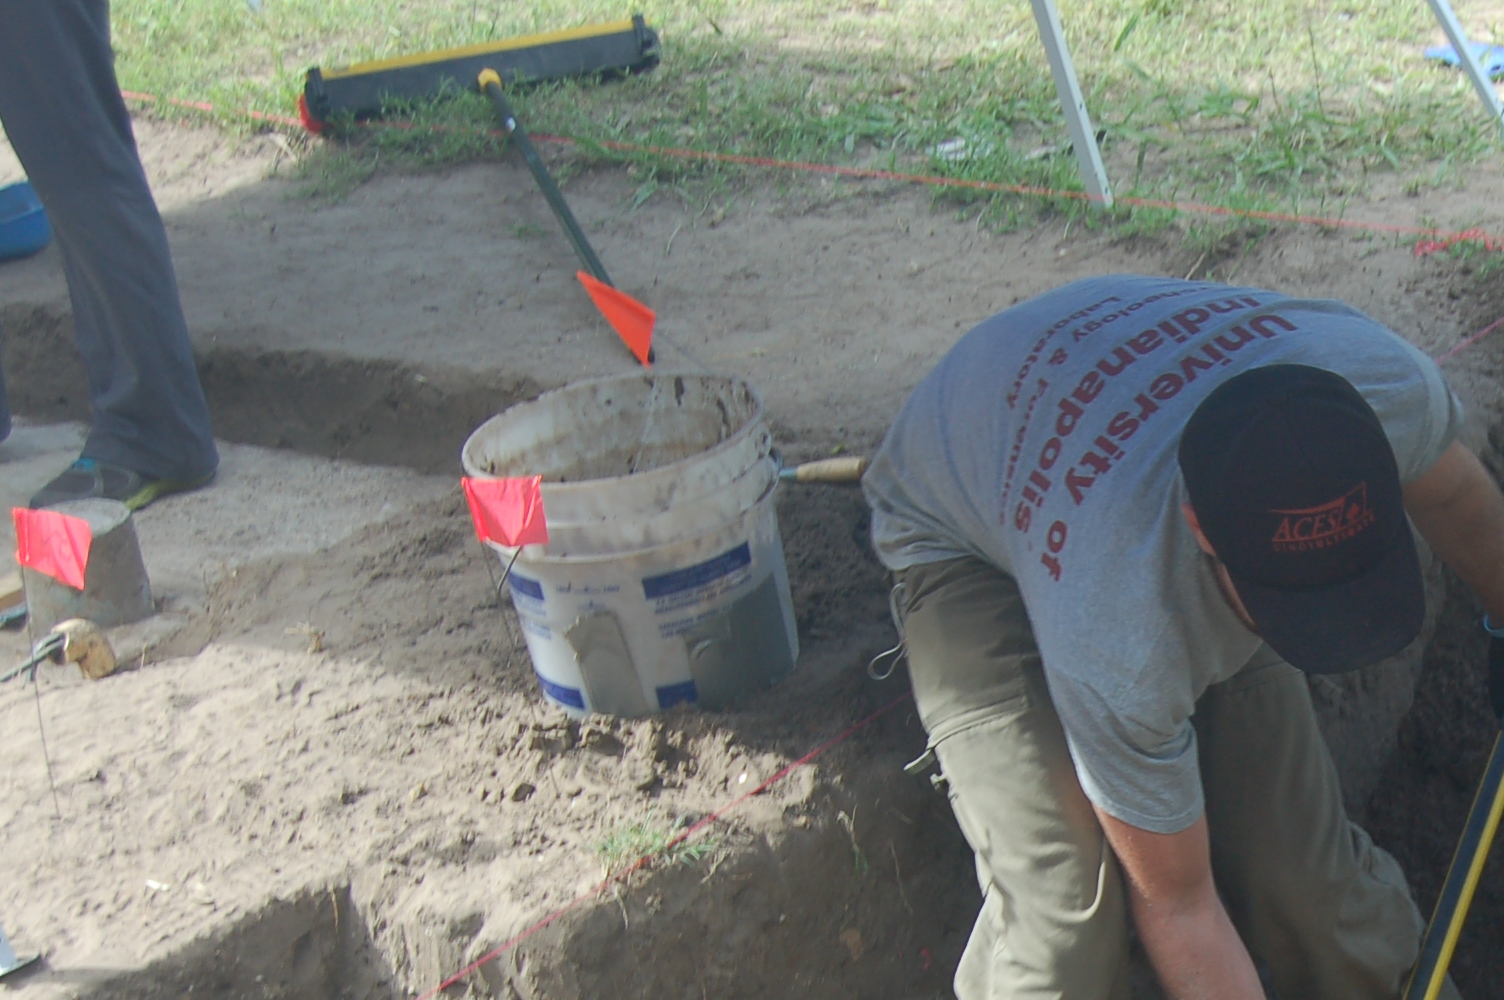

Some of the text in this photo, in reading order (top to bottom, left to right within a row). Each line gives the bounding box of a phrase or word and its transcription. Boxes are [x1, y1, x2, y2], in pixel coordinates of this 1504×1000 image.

[1007, 296, 1121, 409] Laboratory
[1015, 297, 1261, 534] Indianapolis
[1041, 314, 1298, 581] University of
